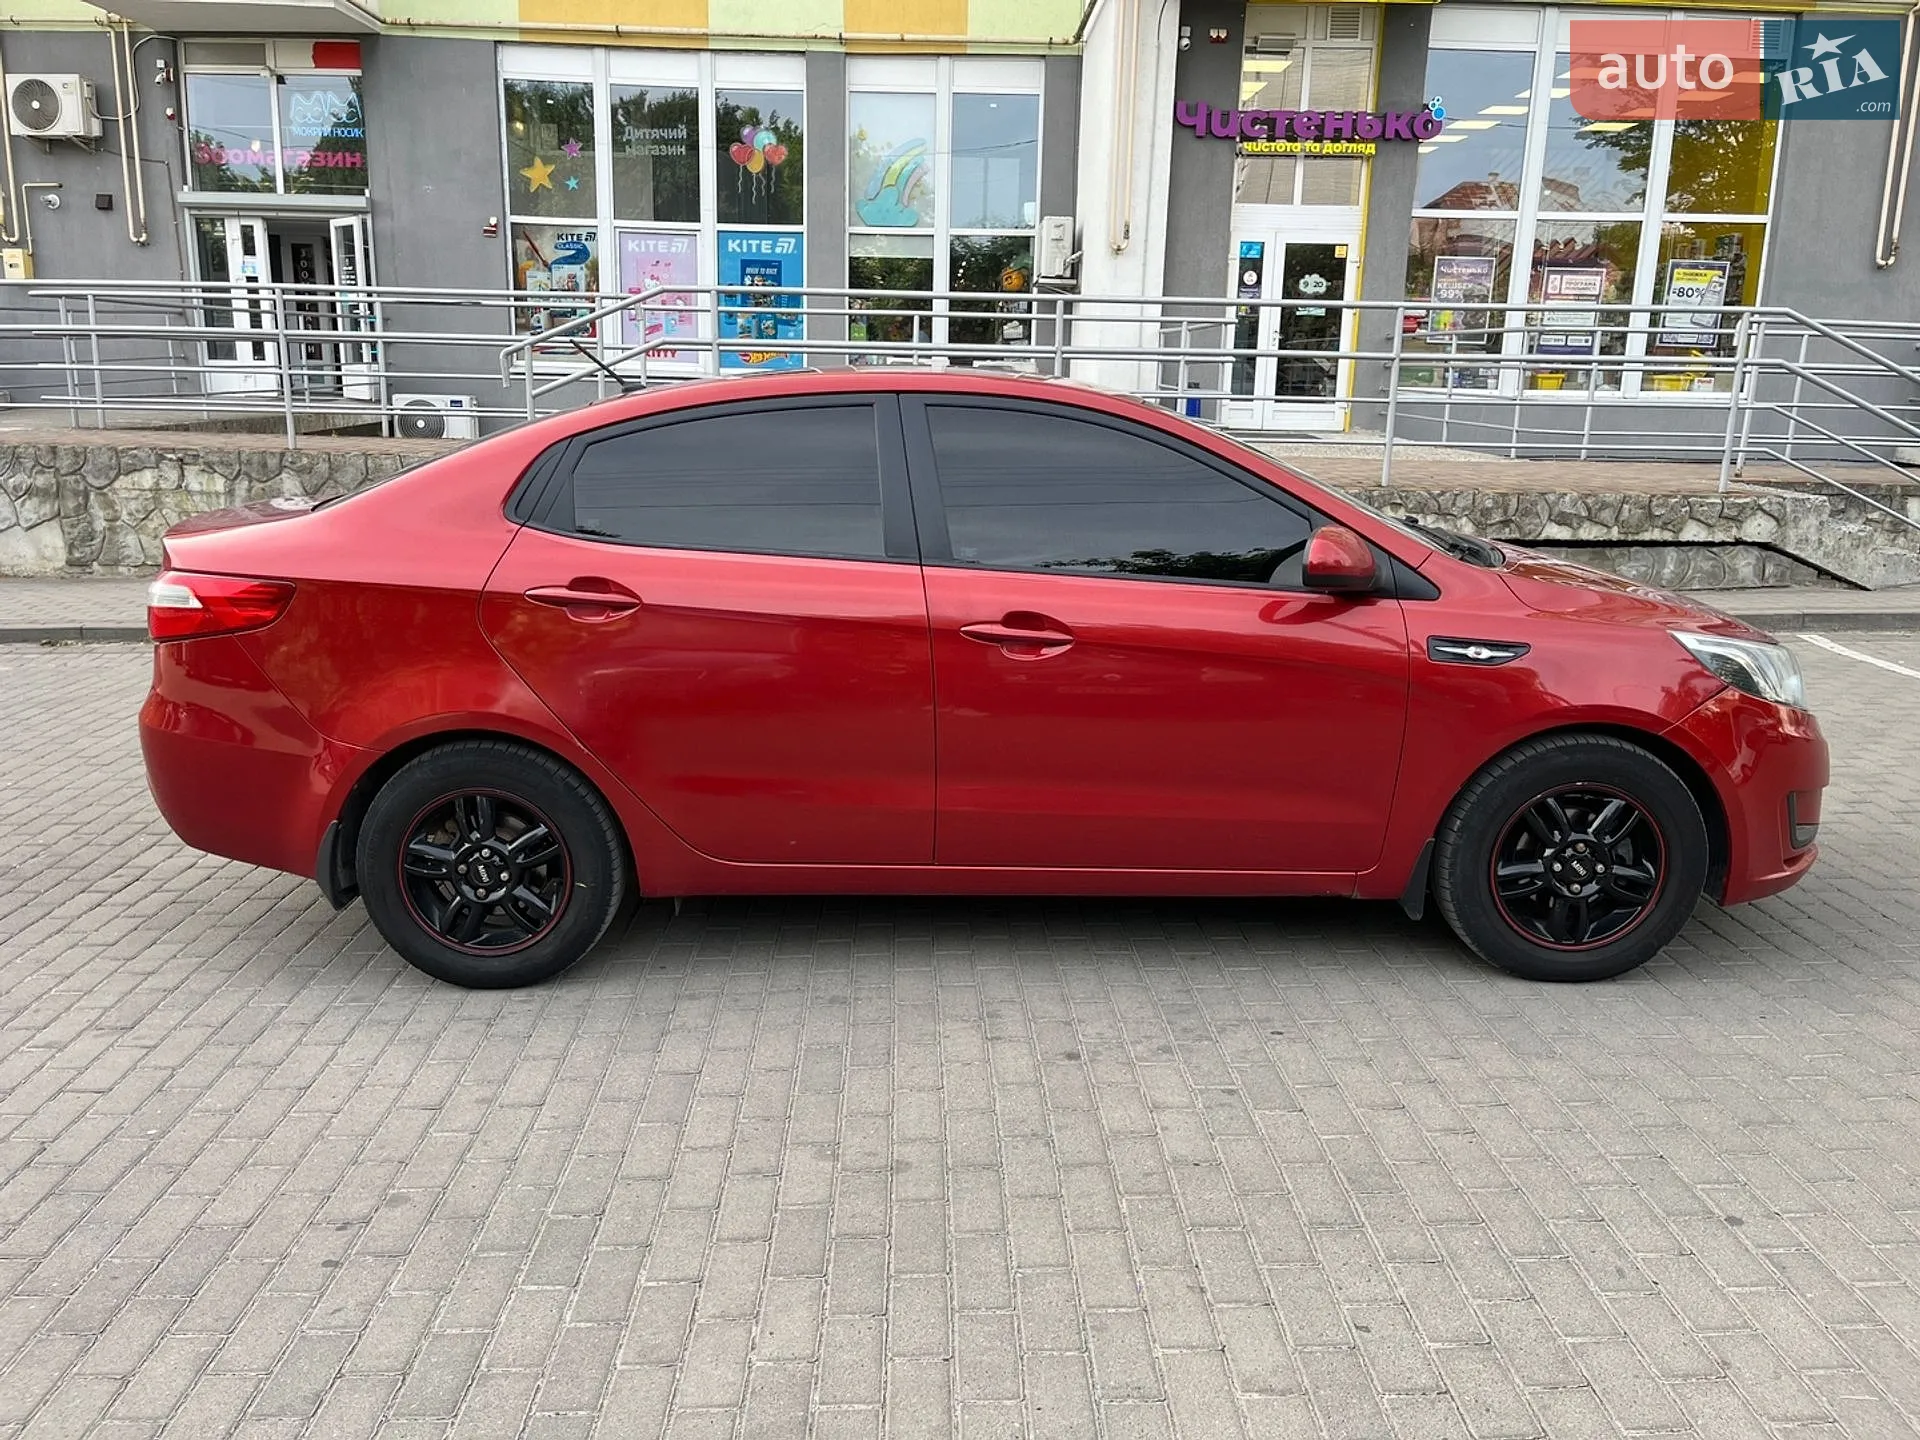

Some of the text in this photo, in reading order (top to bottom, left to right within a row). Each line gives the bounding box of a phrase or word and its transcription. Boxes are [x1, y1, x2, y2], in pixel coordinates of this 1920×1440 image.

[1175, 99, 1444, 140] Чистенько
[623, 124, 687, 142] Дитячий
[625, 144, 687, 156] магазин
[1243, 141, 1376, 155] чистота та догляд
[556, 233, 583, 241] KITE
[627, 239, 669, 253] KITE
[727, 239, 773, 254] KITE
[1440, 265, 1488, 274] Чистенько
